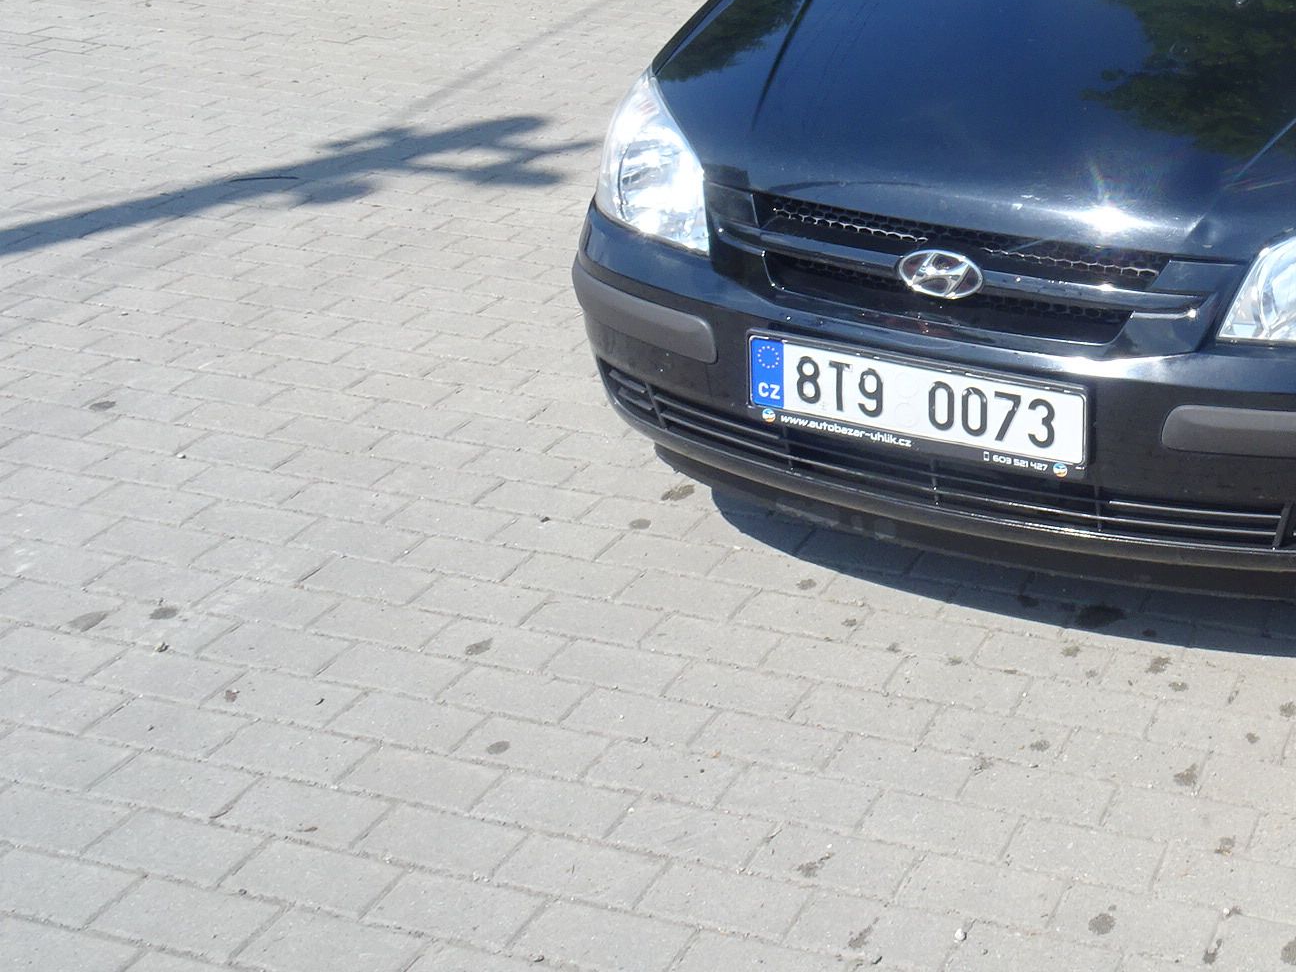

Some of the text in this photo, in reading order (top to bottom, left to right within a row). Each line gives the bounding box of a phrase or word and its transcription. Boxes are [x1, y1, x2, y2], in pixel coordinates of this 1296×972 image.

[757, 381, 781, 400] CZ
[796, 355, 1056, 449] 8T9 0073
[992, 454, 1049, 471] 603 521 427
